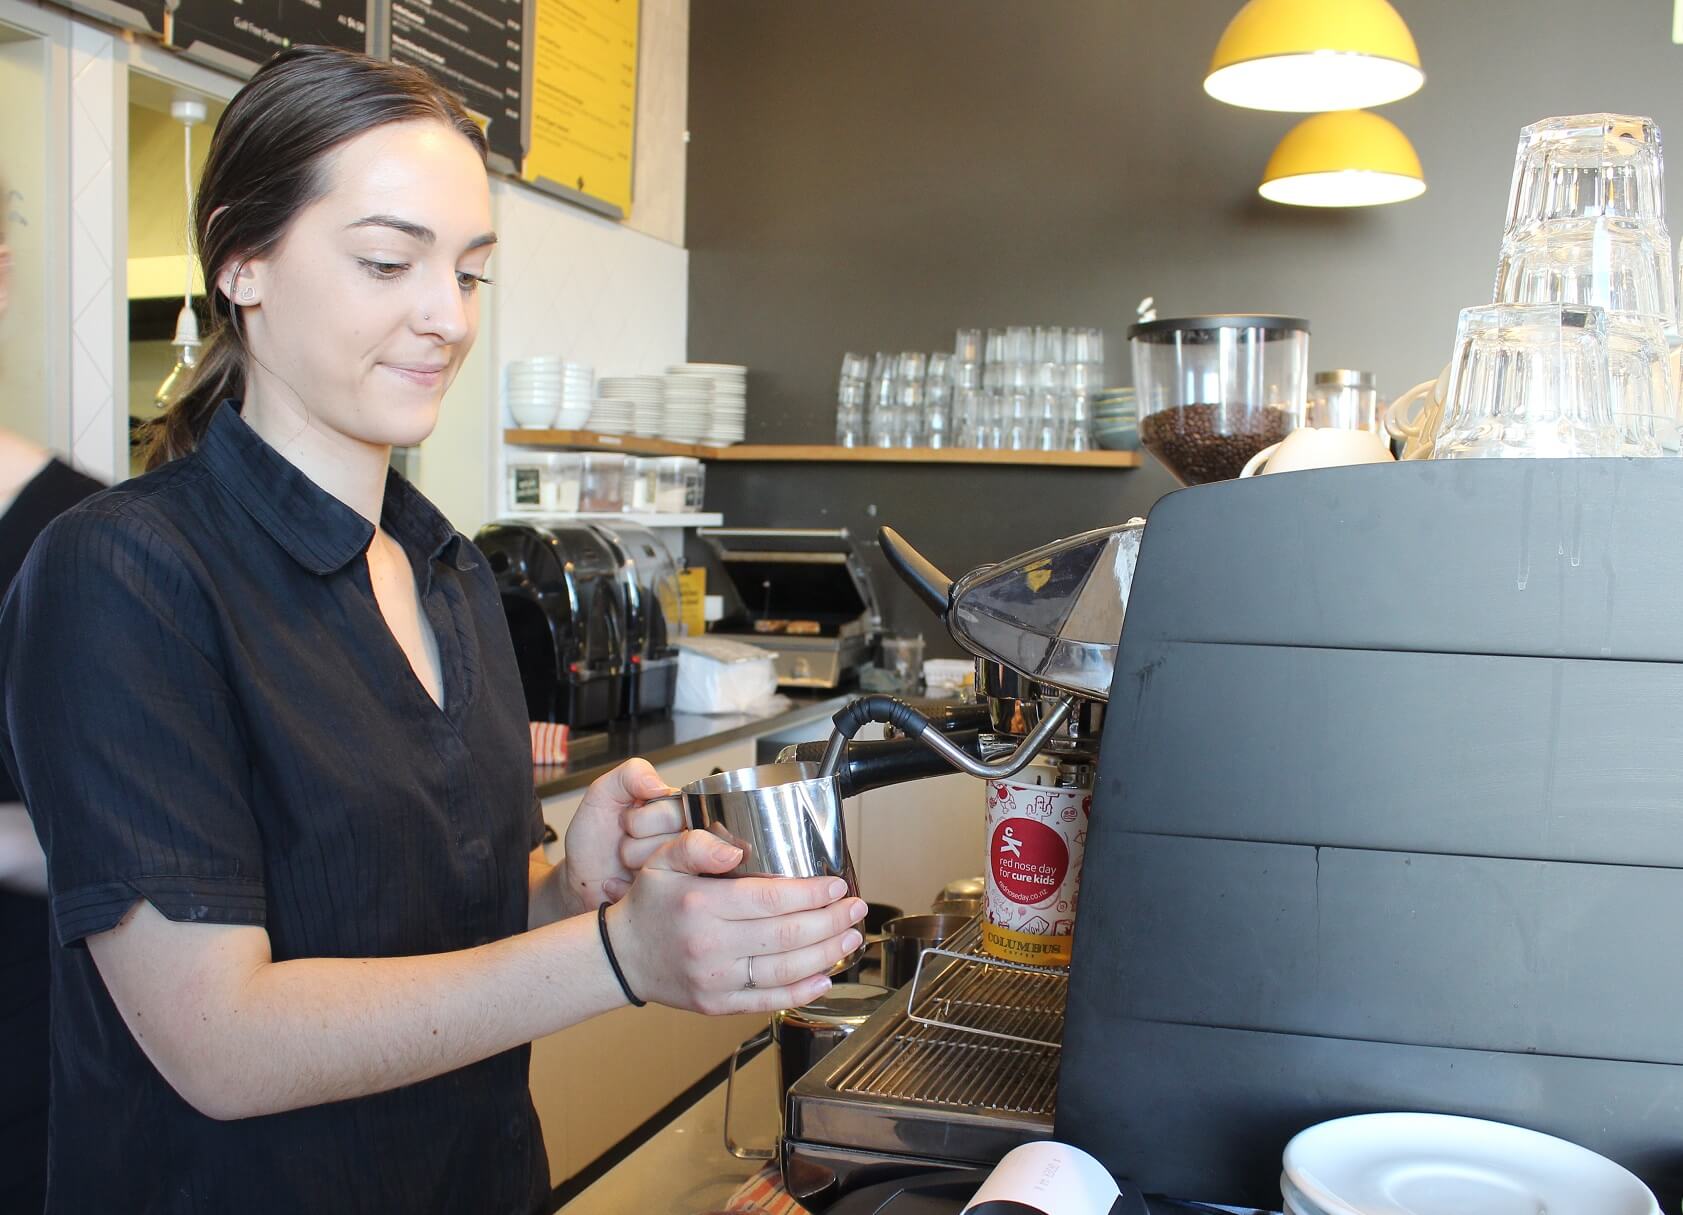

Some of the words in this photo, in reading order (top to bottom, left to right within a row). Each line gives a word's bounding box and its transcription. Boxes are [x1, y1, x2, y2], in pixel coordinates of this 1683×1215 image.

[999, 858, 1013, 868] red
[1014, 861, 1037, 873] nose
[1038, 864, 1057, 877] day
[999, 866, 1012, 878] for
[1011, 872, 1032, 883] cure
[1033, 873, 1055, 885] kids
[999, 881, 1048, 902] rednoseday.co.nz
[987, 932, 1062, 954] COLUMBUS
